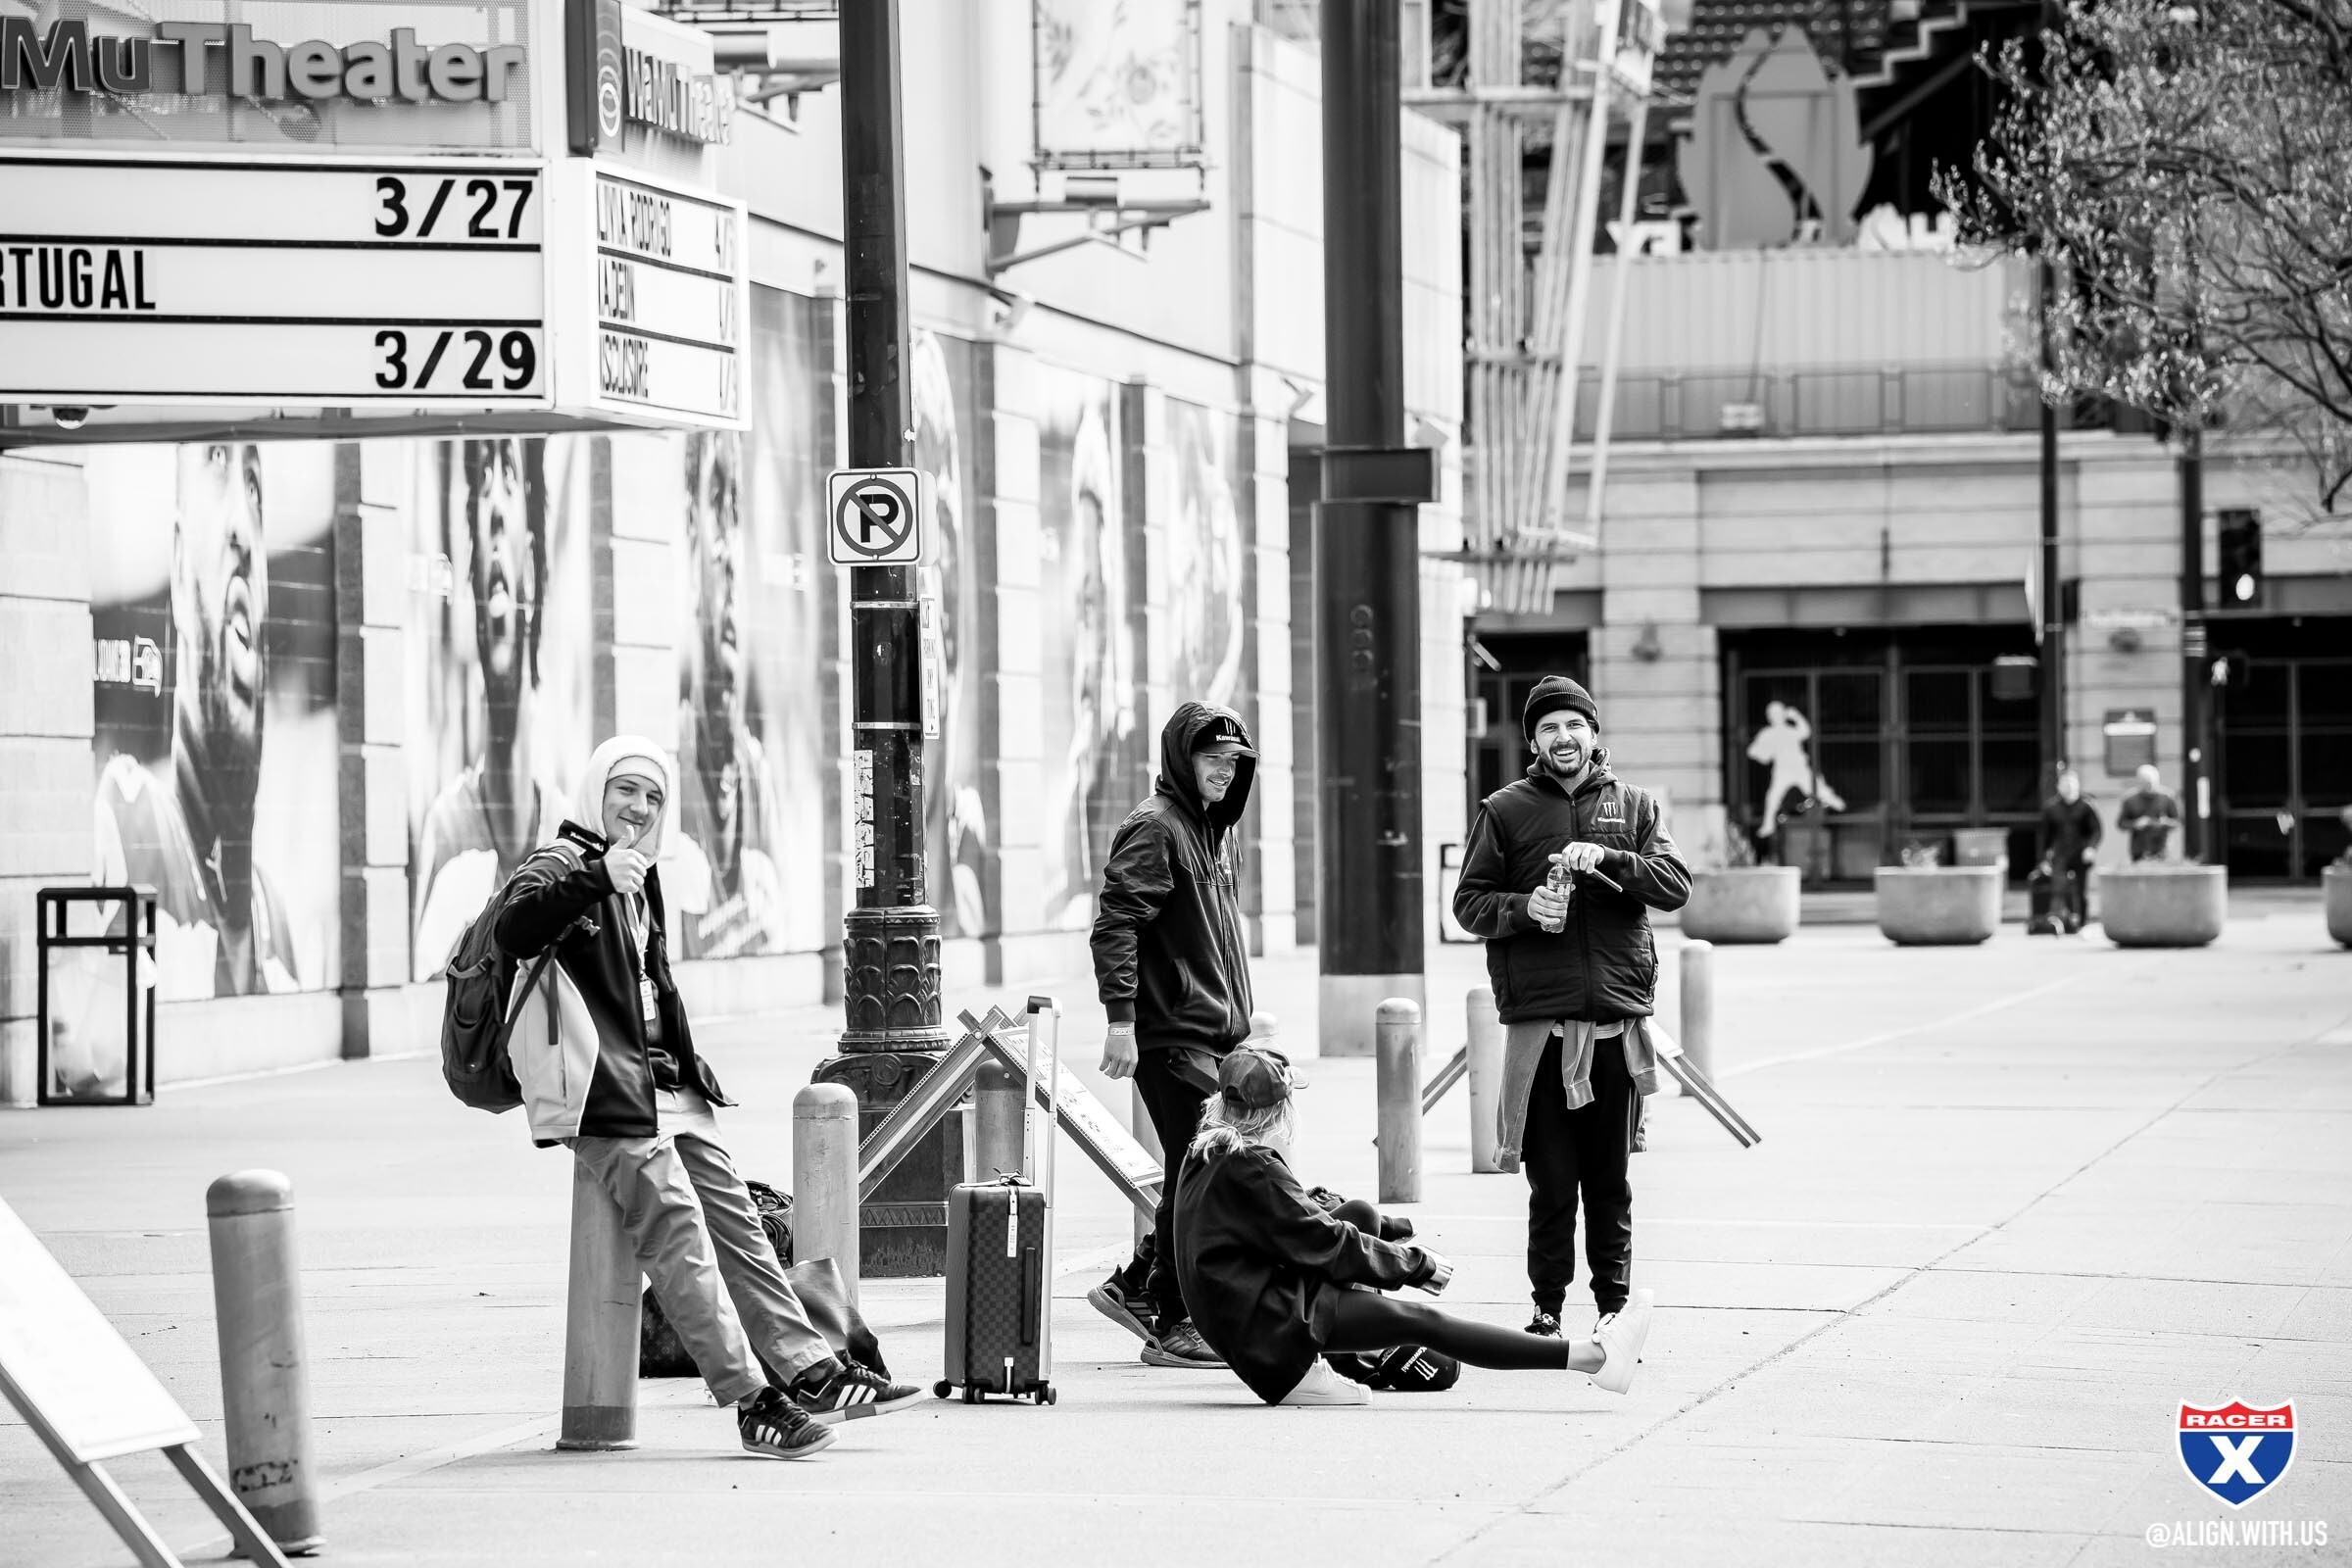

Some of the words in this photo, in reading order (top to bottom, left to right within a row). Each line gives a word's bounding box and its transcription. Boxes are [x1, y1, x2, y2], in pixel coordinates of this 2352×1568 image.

[156, 21, 527, 103] Theater
[373, 176, 534, 239] 3/27
[0, 247, 157, 311] TUGAL
[373, 329, 537, 391] 3/29
